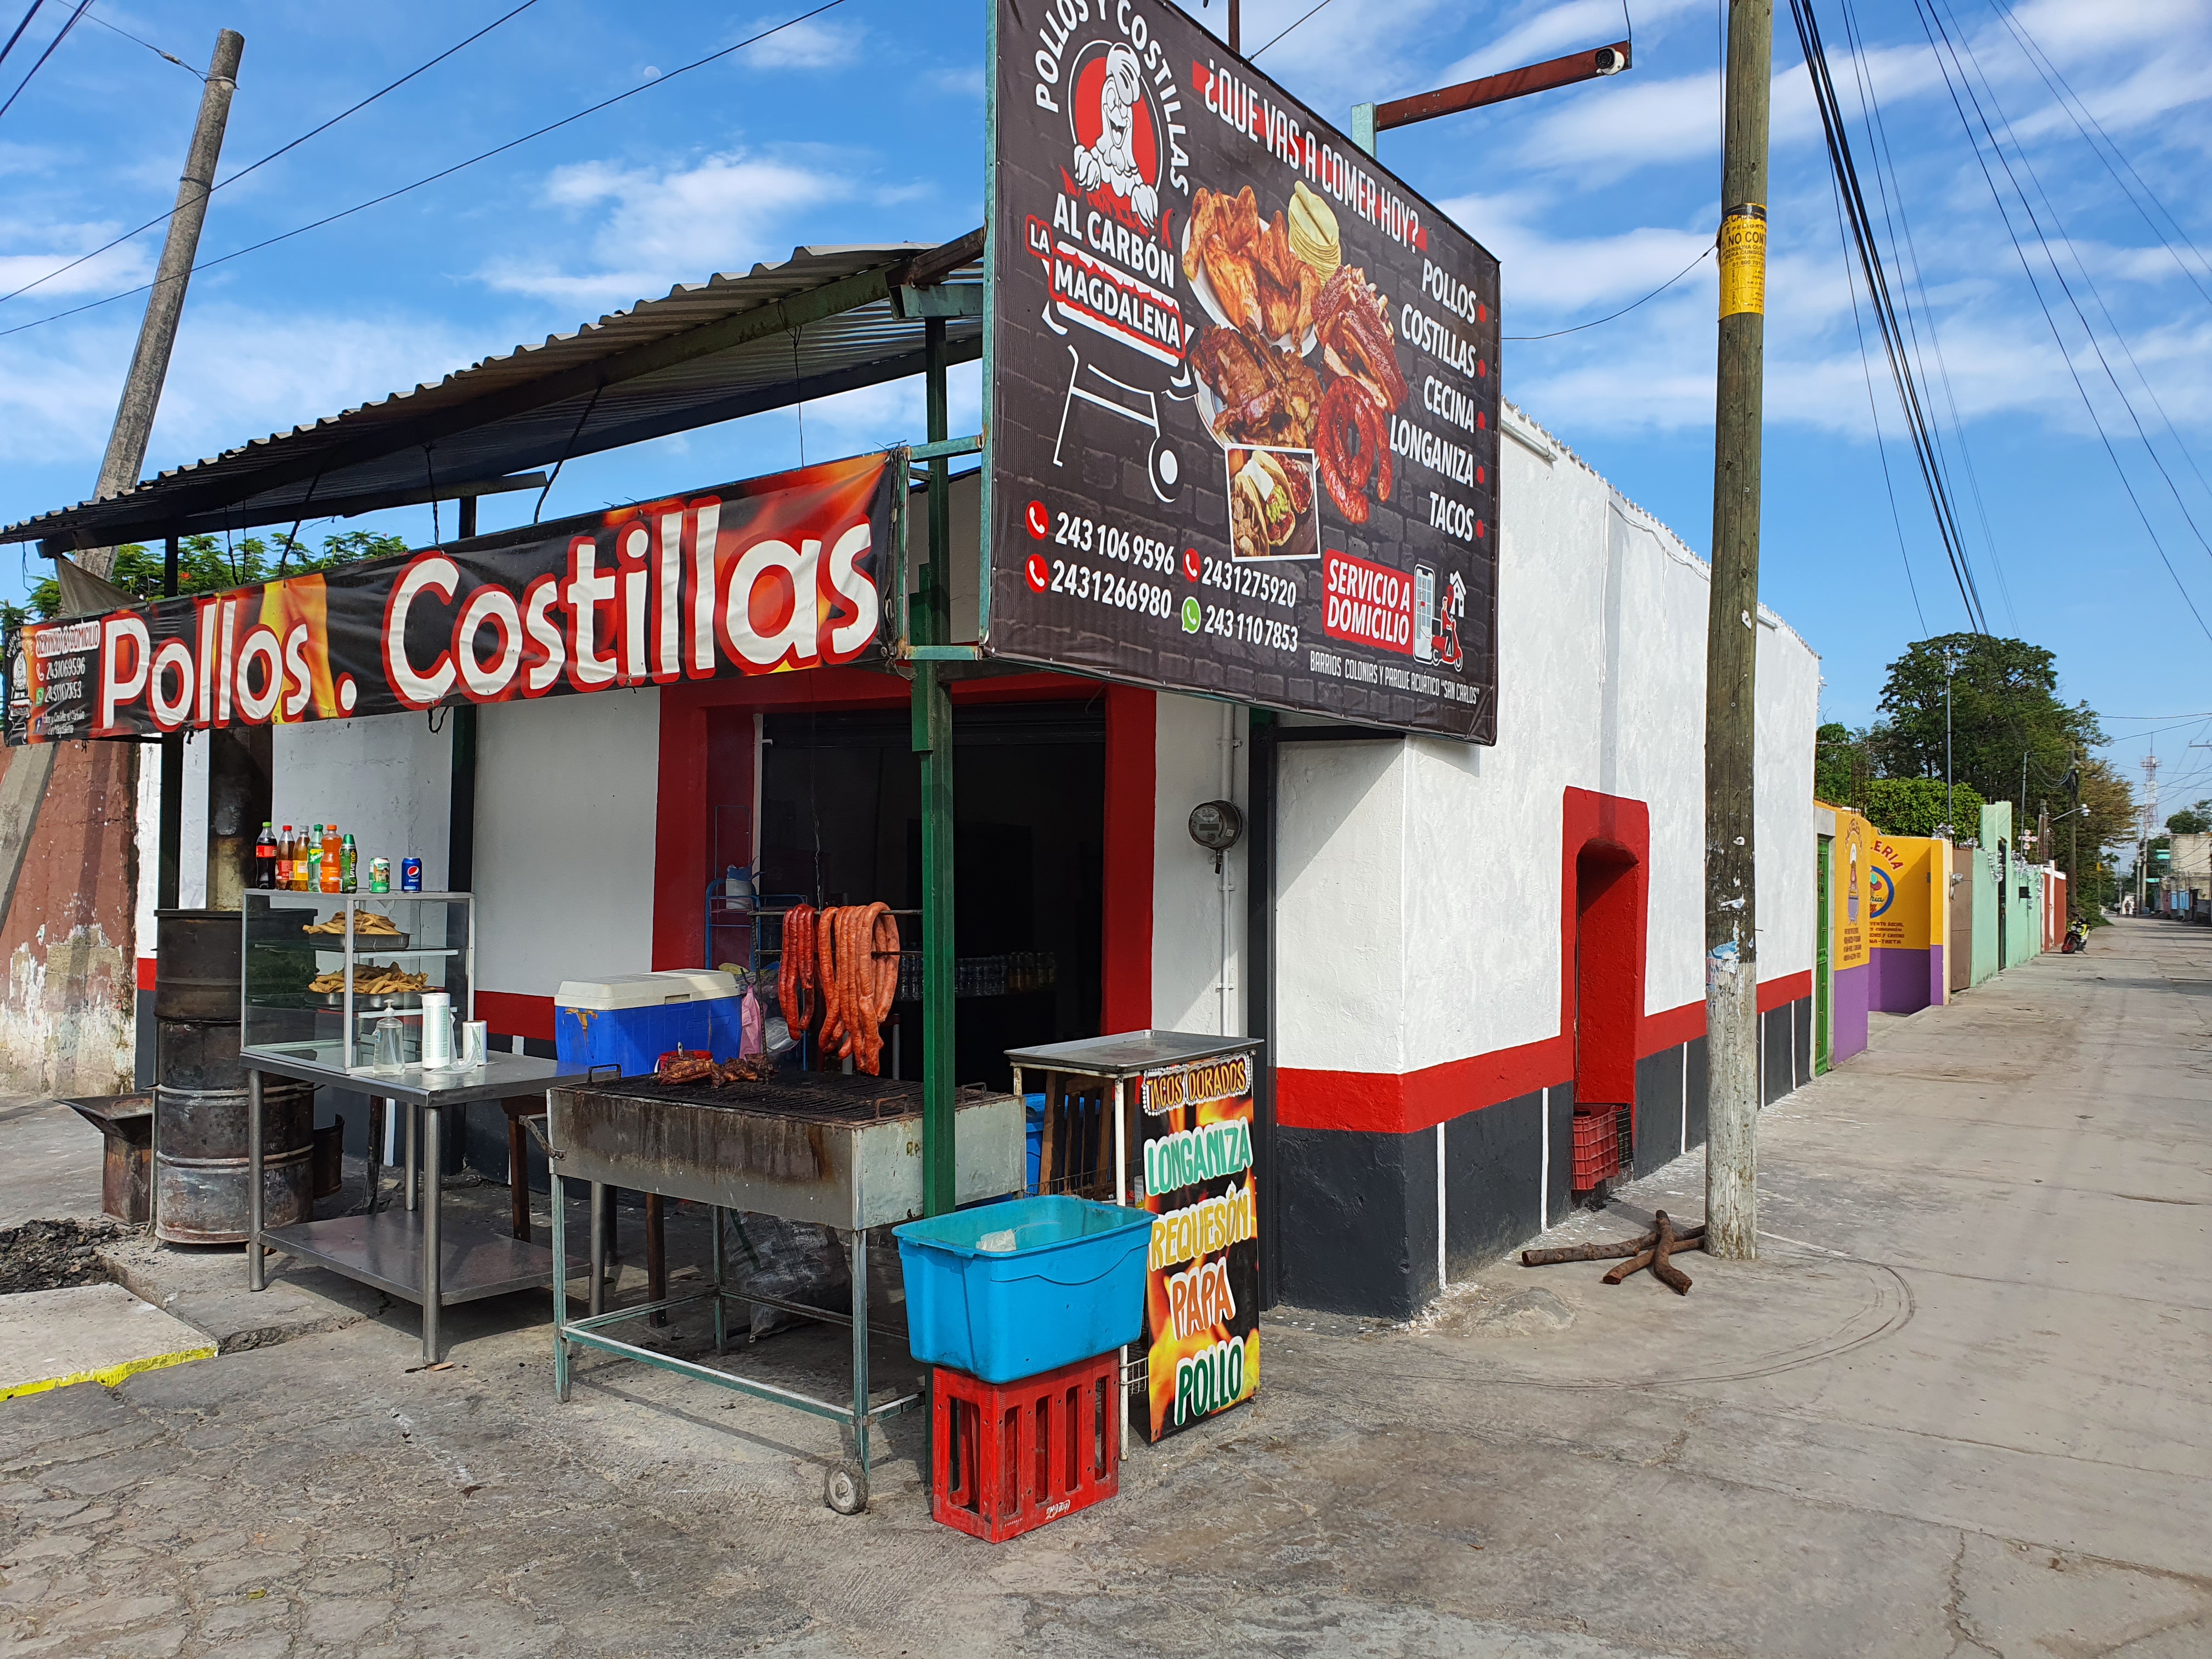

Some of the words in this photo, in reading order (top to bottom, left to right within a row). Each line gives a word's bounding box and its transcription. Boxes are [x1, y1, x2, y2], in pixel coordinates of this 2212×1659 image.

[1035, 0, 1089, 113] POLLOS
[1117, 0, 1189, 196] COSTILLAS
[1205, 58, 1258, 143] ¿QUE
[1263, 98, 1299, 171] VAS
[1305, 131, 1316, 183] A
[1322, 143, 1376, 227] COMER
[1381, 186, 1419, 254] HOY?
[1030, 223, 1050, 255] LA
[1053, 192, 1082, 241] AL
[1087, 211, 1174, 289] CARBÓN
[1728, 232, 1742, 247] NO
[1054, 258, 1181, 349] MAGDALENA
[1421, 258, 1477, 325] POLLOS
[1401, 303, 1476, 379] COSTILLAS
[1423, 375, 1475, 433] CECINA
[1389, 414, 1474, 488] LONGANIZA
[1429, 491, 1475, 542] TACOS
[385, 500, 881, 706] Costillas
[1050, 560, 1172, 619] 2431266980
[1201, 556, 1297, 608] 2431275920
[1327, 558, 1399, 608] SERVICIO
[1400, 582, 1410, 613] A
[36, 631, 61, 655] SERVICIO
[63, 632, 69, 652] A
[70, 624, 99, 649] DOMICILIO
[1327, 595, 1410, 646] DOMICILIO
[44, 680, 82, 703] 2431107853
[46, 656, 85, 680] 2431069596
[1310, 650, 1342, 677] BARRIOS
[1345, 658, 1378, 684] COLONIAS
[1380, 665, 1385, 685] Y
[1385, 667, 1410, 691] PARQUE
[1411, 671, 1440, 697] ACUÁTICO
[1870, 840, 1904, 870] ERIA
[1146, 1071, 1184, 1111] TACOS
[1188, 1059, 1246, 1101] DORADOS
[1147, 1123, 1251, 1195] LONGANIZA
[1151, 1190, 1249, 1271] REQUESÓN
[1172, 1265, 1234, 1341] PAPA
[1177, 1344, 1242, 1425] POLLO
